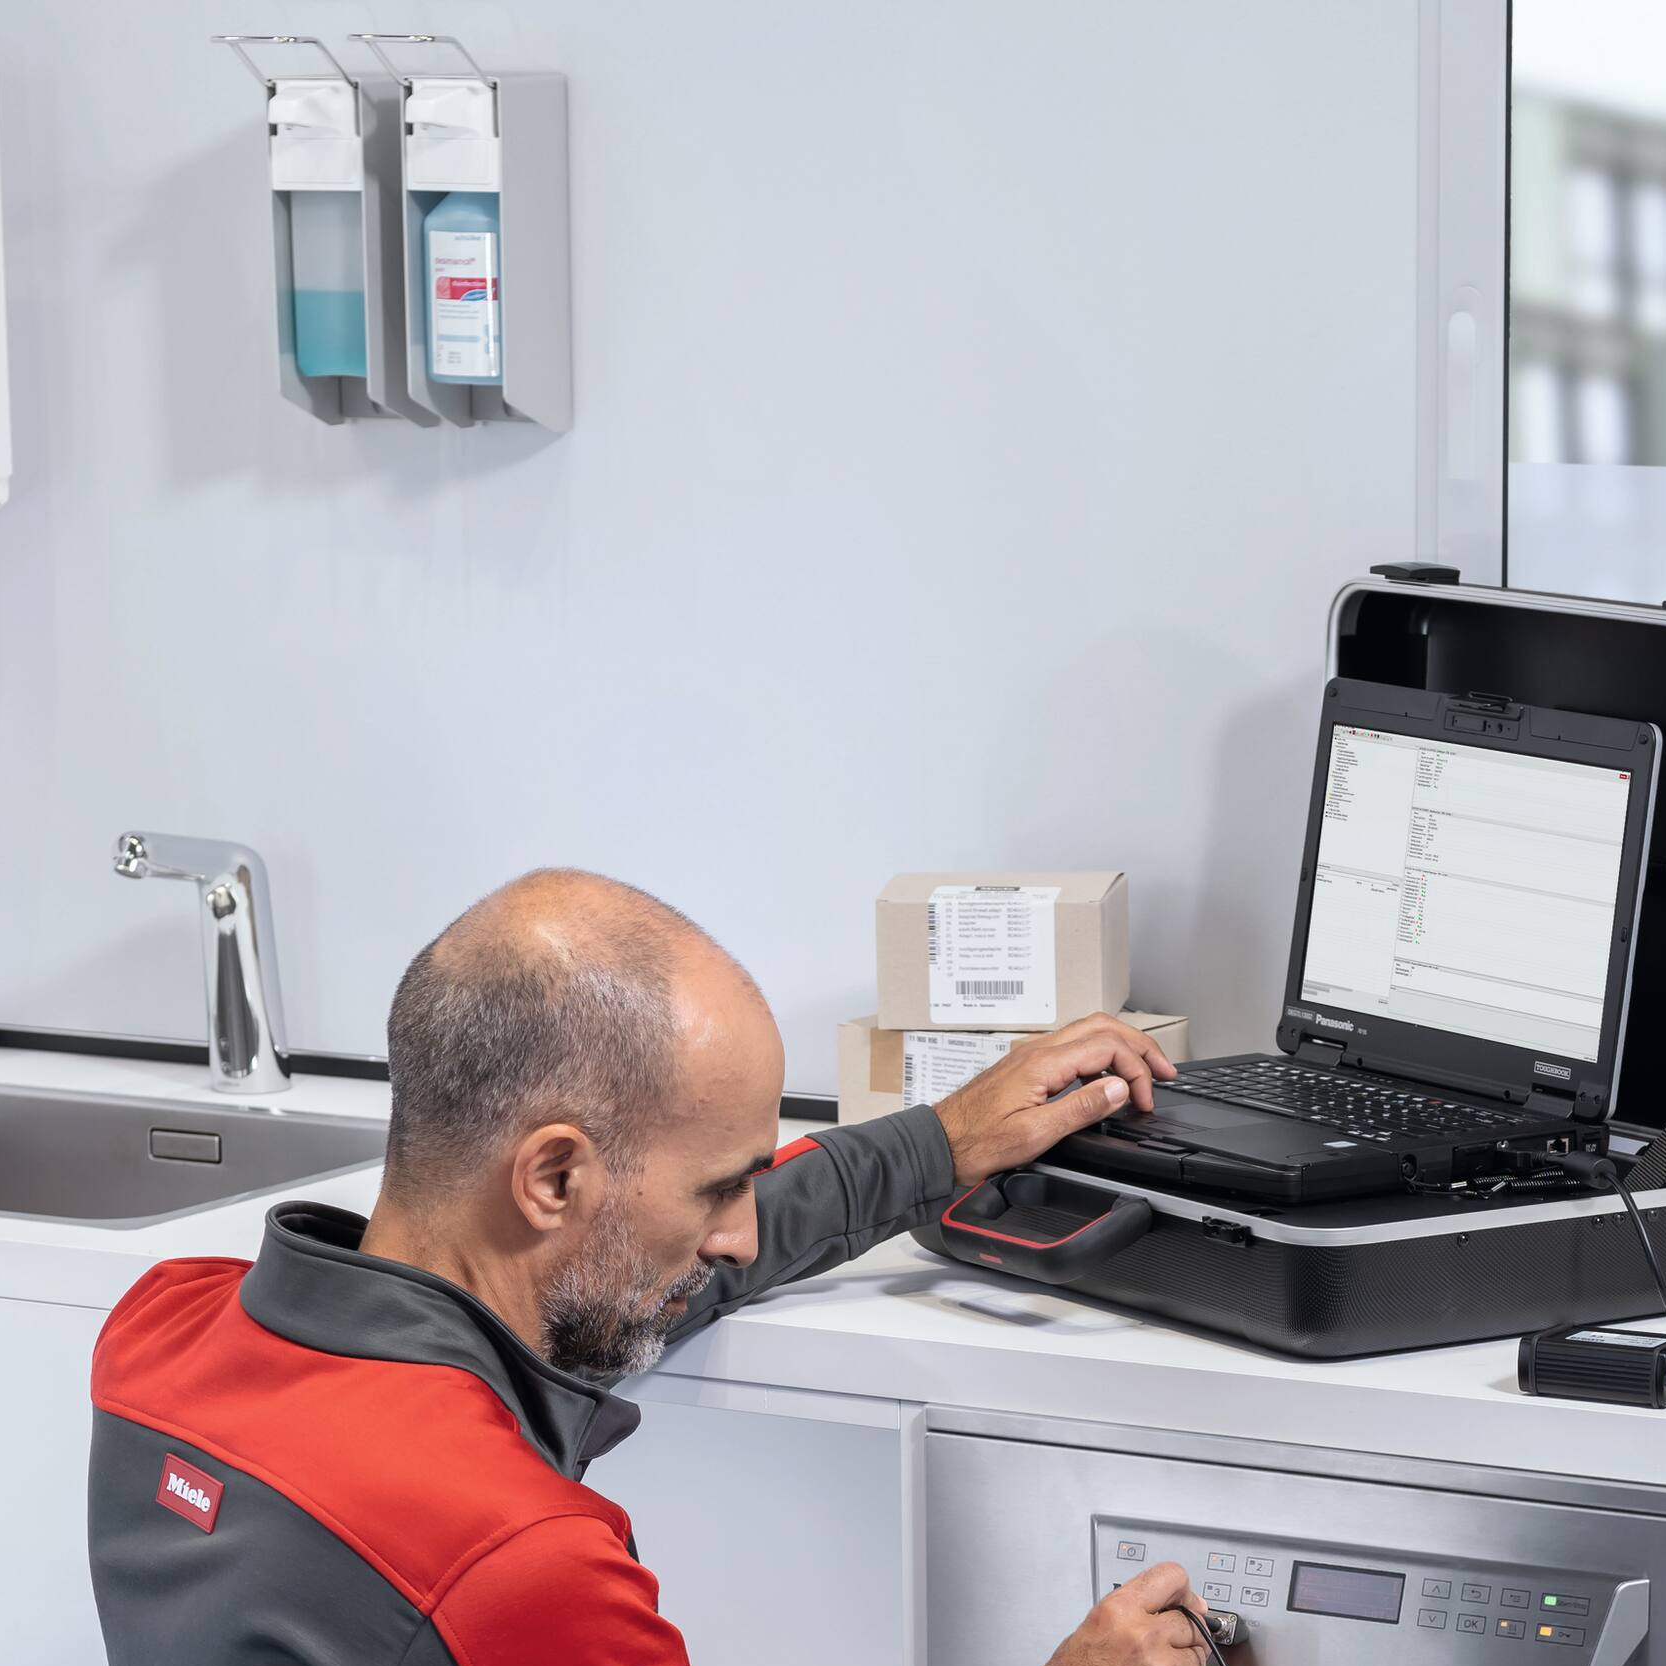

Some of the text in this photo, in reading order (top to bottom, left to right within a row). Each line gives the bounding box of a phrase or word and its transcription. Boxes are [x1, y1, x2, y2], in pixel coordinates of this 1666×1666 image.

[1315, 1013, 1354, 1032] Panasonic
[1536, 1064, 1570, 1077] TOUGHBOOK
[166, 1472, 211, 1513] Miele
[1256, 1563, 1263, 1572] 2
[1213, 1588, 1221, 1597] 3
[1463, 1619, 1479, 1630] OK
